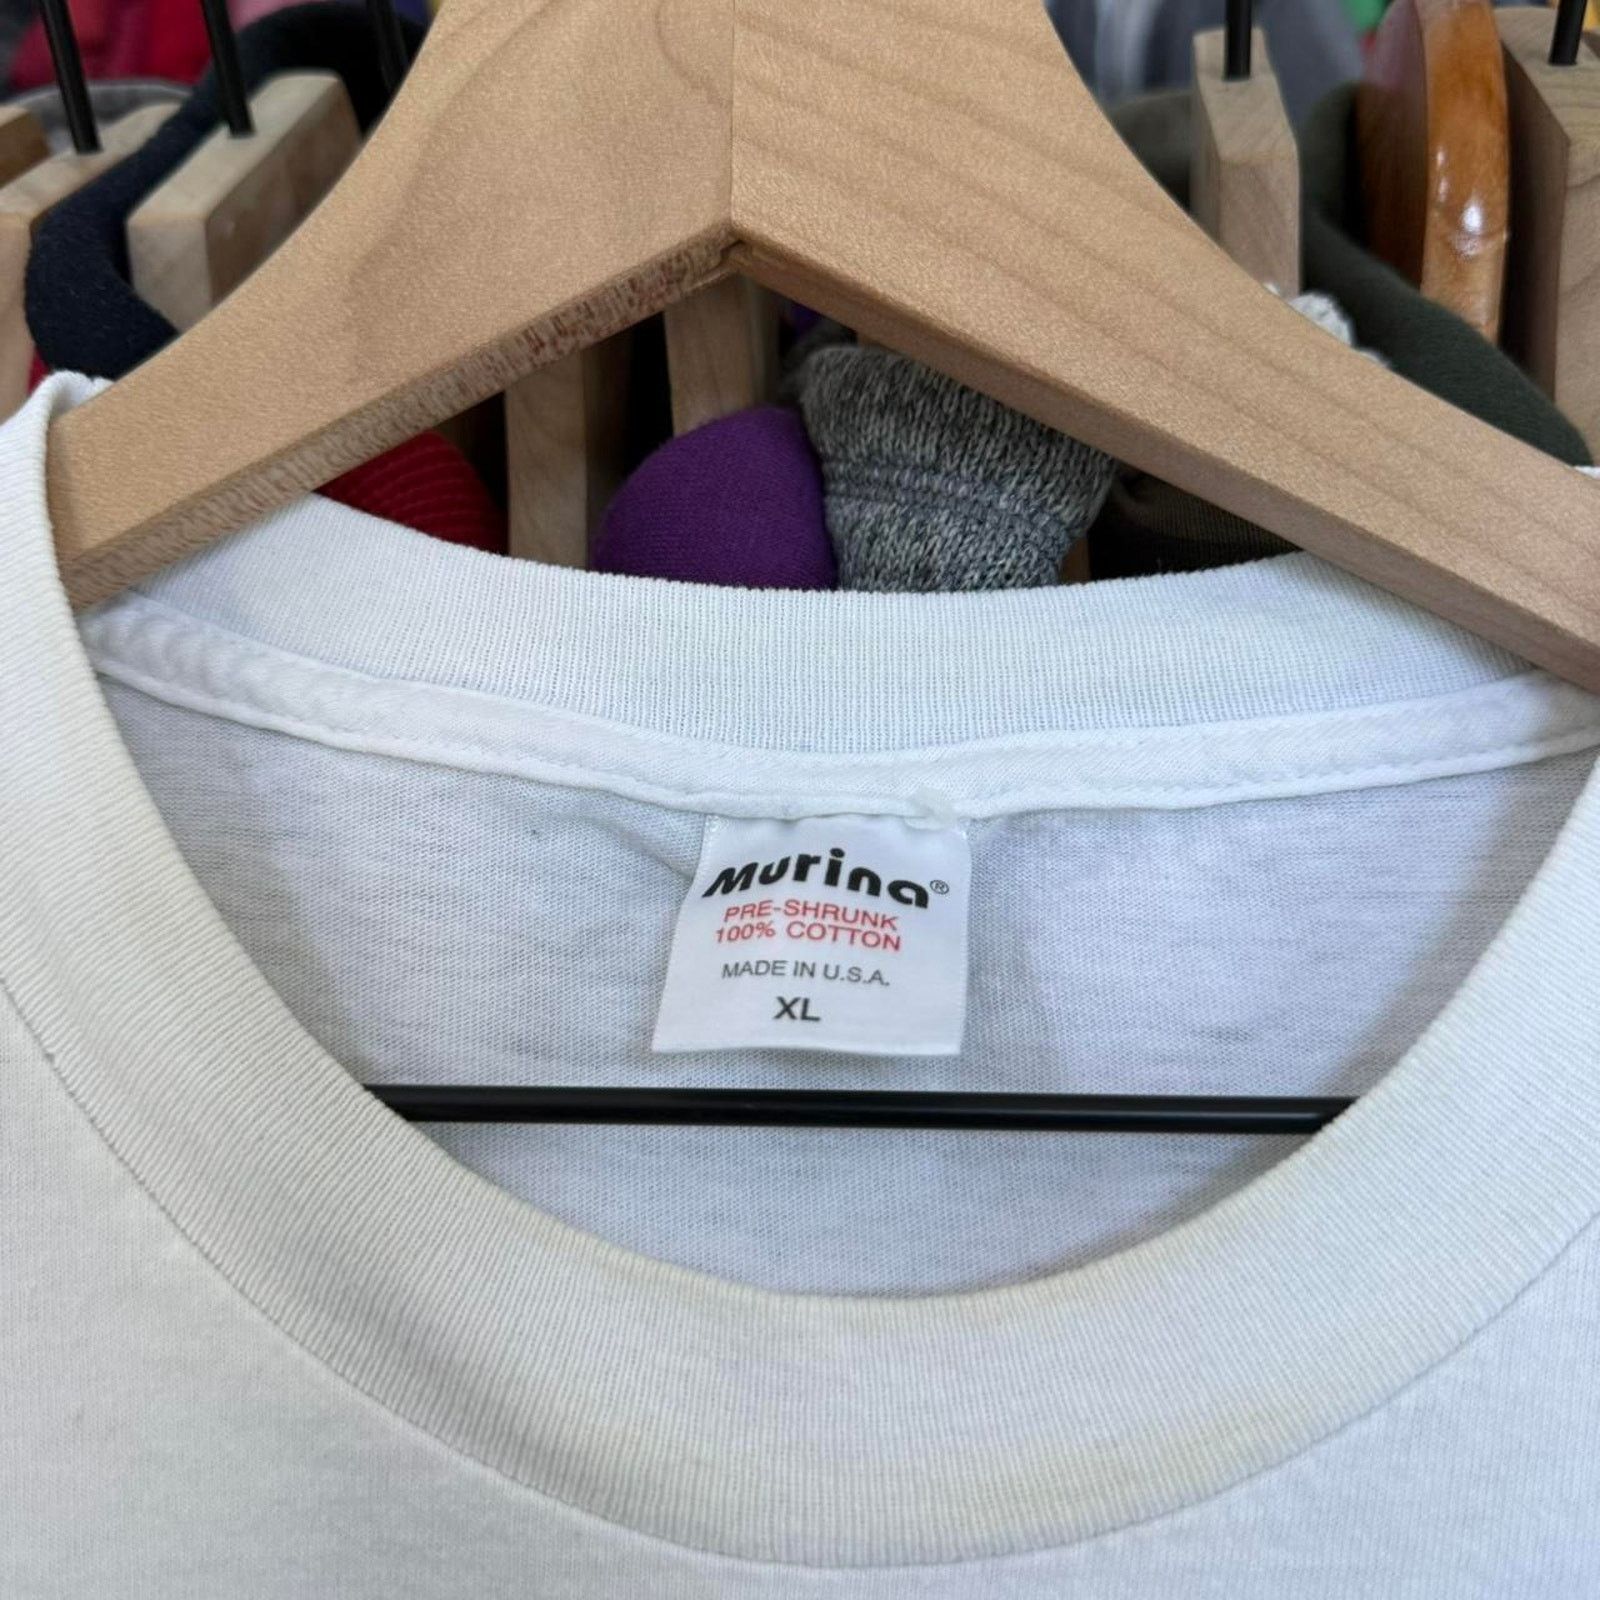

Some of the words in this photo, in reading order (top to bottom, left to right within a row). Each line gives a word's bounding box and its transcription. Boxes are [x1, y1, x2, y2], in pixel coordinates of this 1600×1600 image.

[723, 899, 898, 931] PRE-SHRUNK
[715, 920, 776, 943] 100%
[786, 921, 901, 951] COTTON
[722, 960, 787, 979] MADE
[793, 961, 815, 978] IN
[823, 963, 890, 986] U.S.A.
[773, 996, 821, 1021] XL
